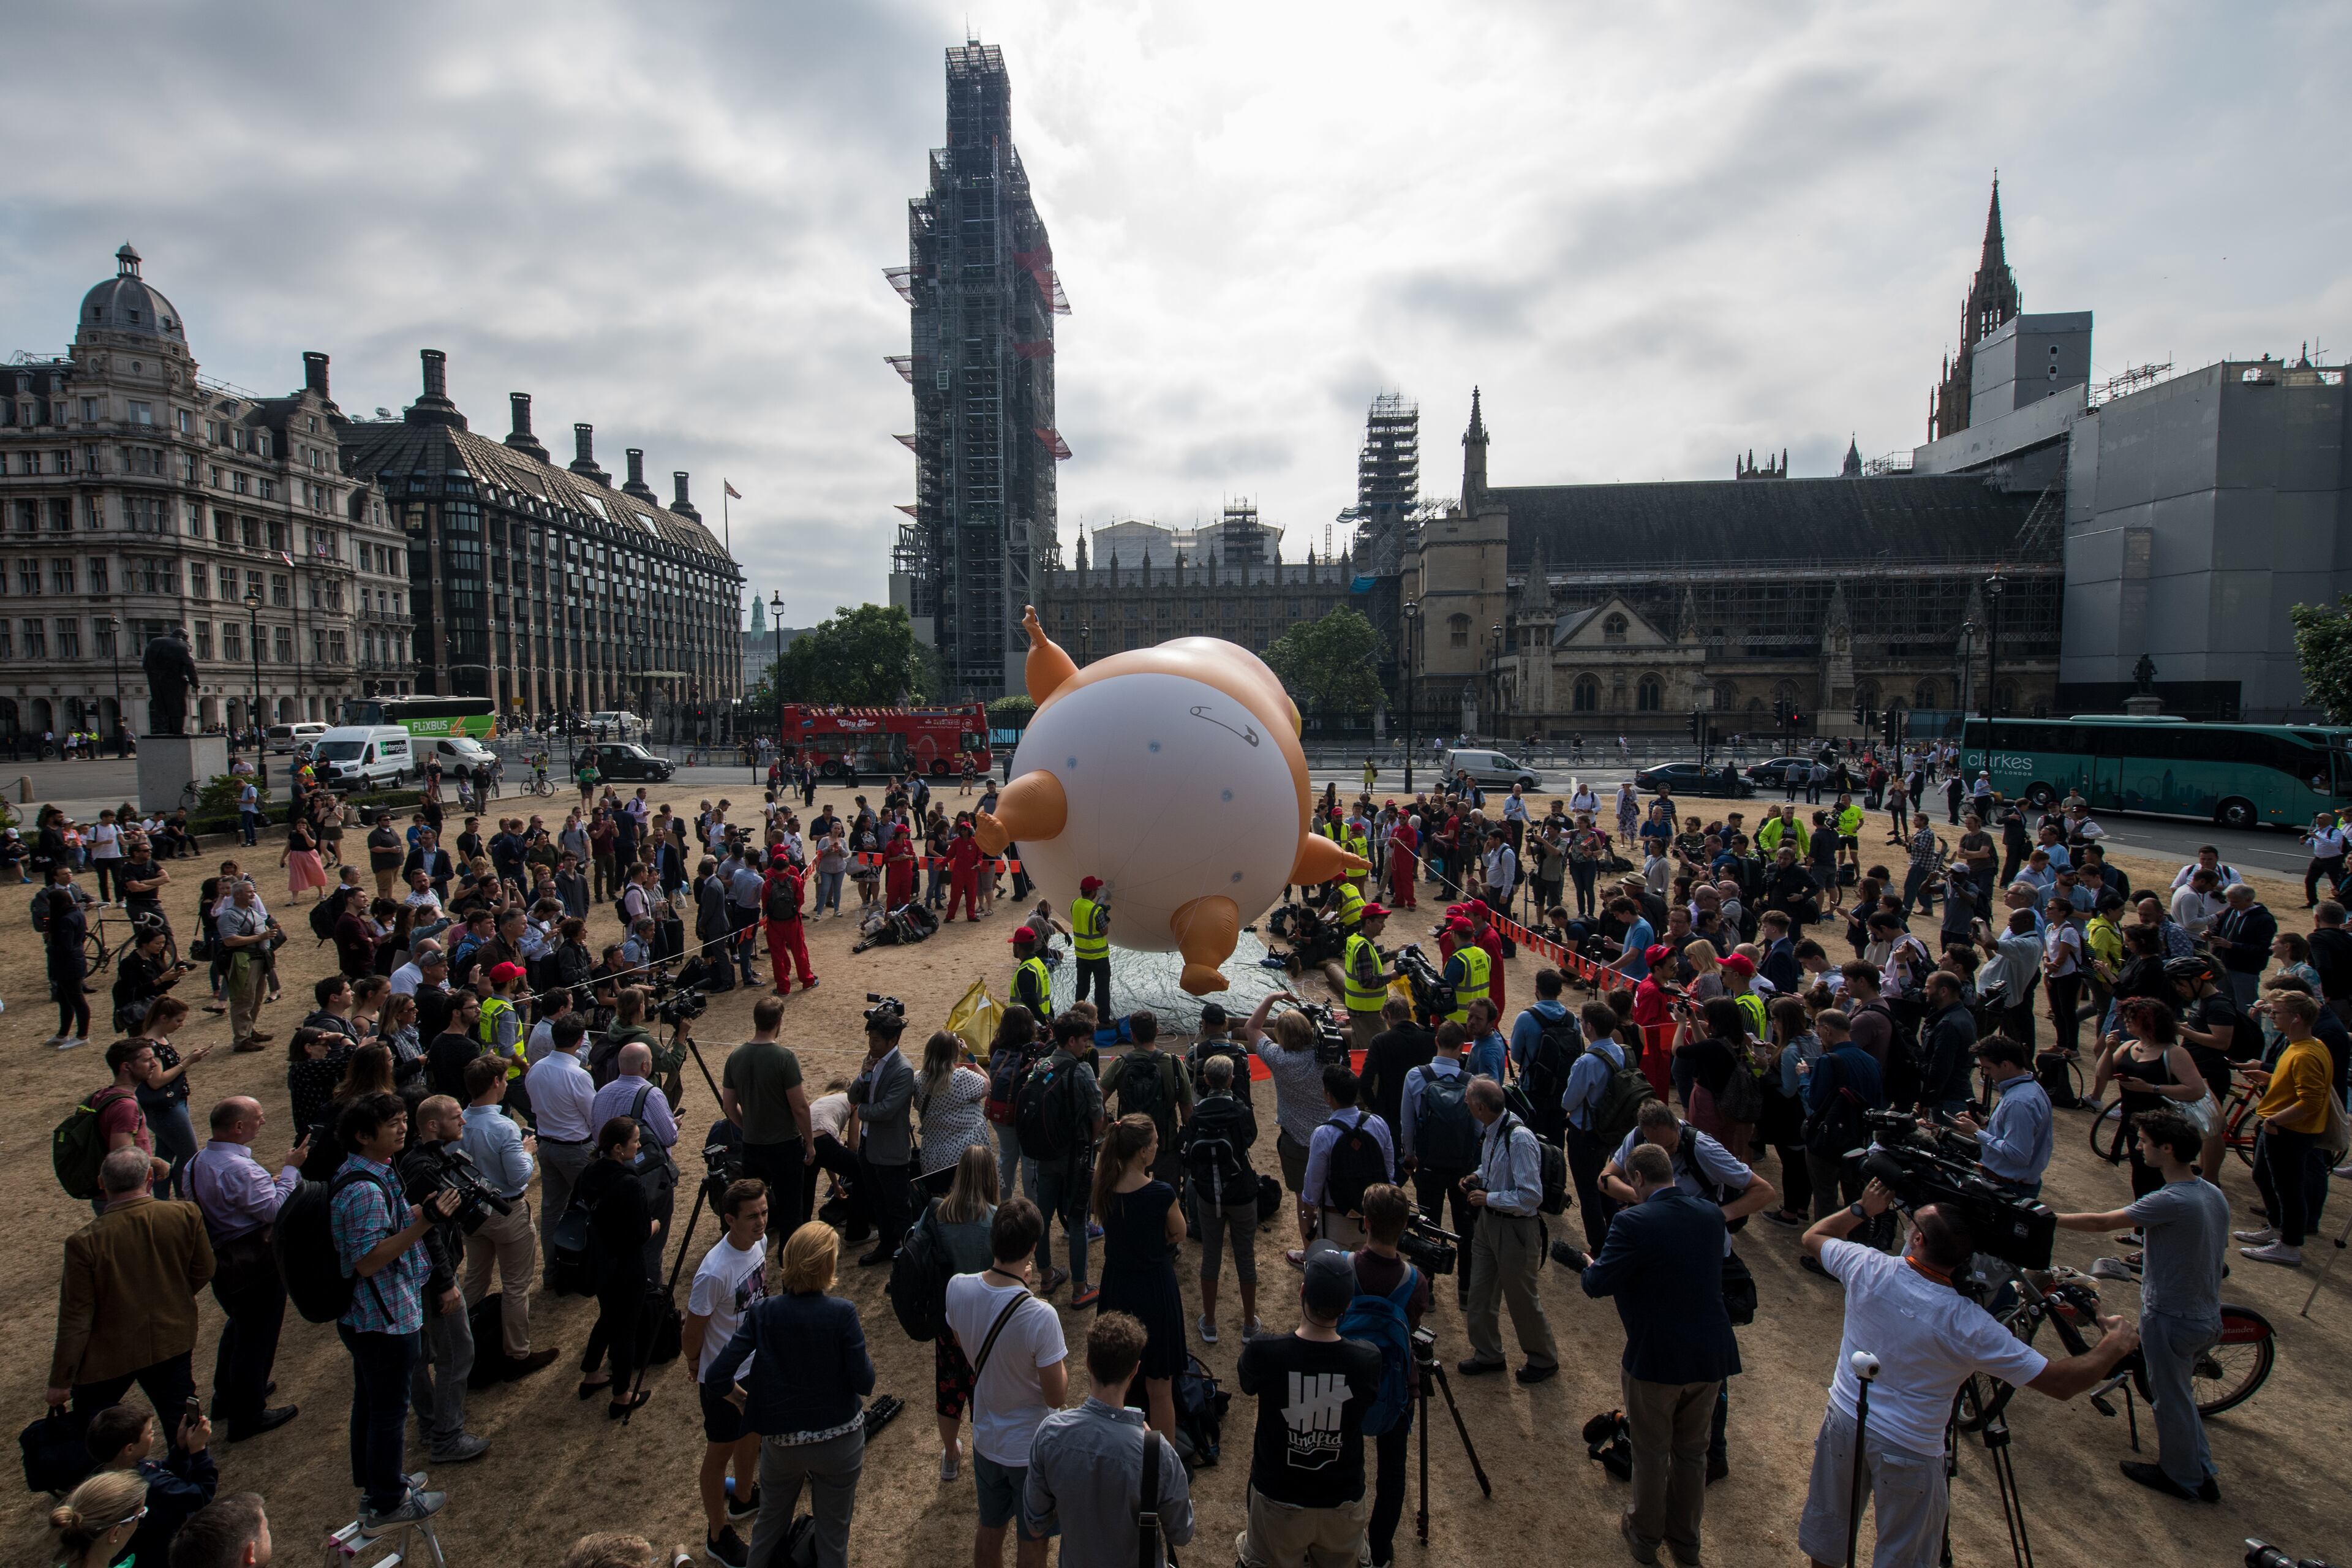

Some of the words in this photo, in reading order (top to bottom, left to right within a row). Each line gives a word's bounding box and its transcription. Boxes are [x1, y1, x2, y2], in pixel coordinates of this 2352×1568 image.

[837, 718, 856, 728] City
[858, 718, 876, 727] Tour
[382, 742, 407, 753] enterprise
[2222, 1325, 2256, 1334] ntander
[1294, 1443, 1316, 1452] OFFICIAL
